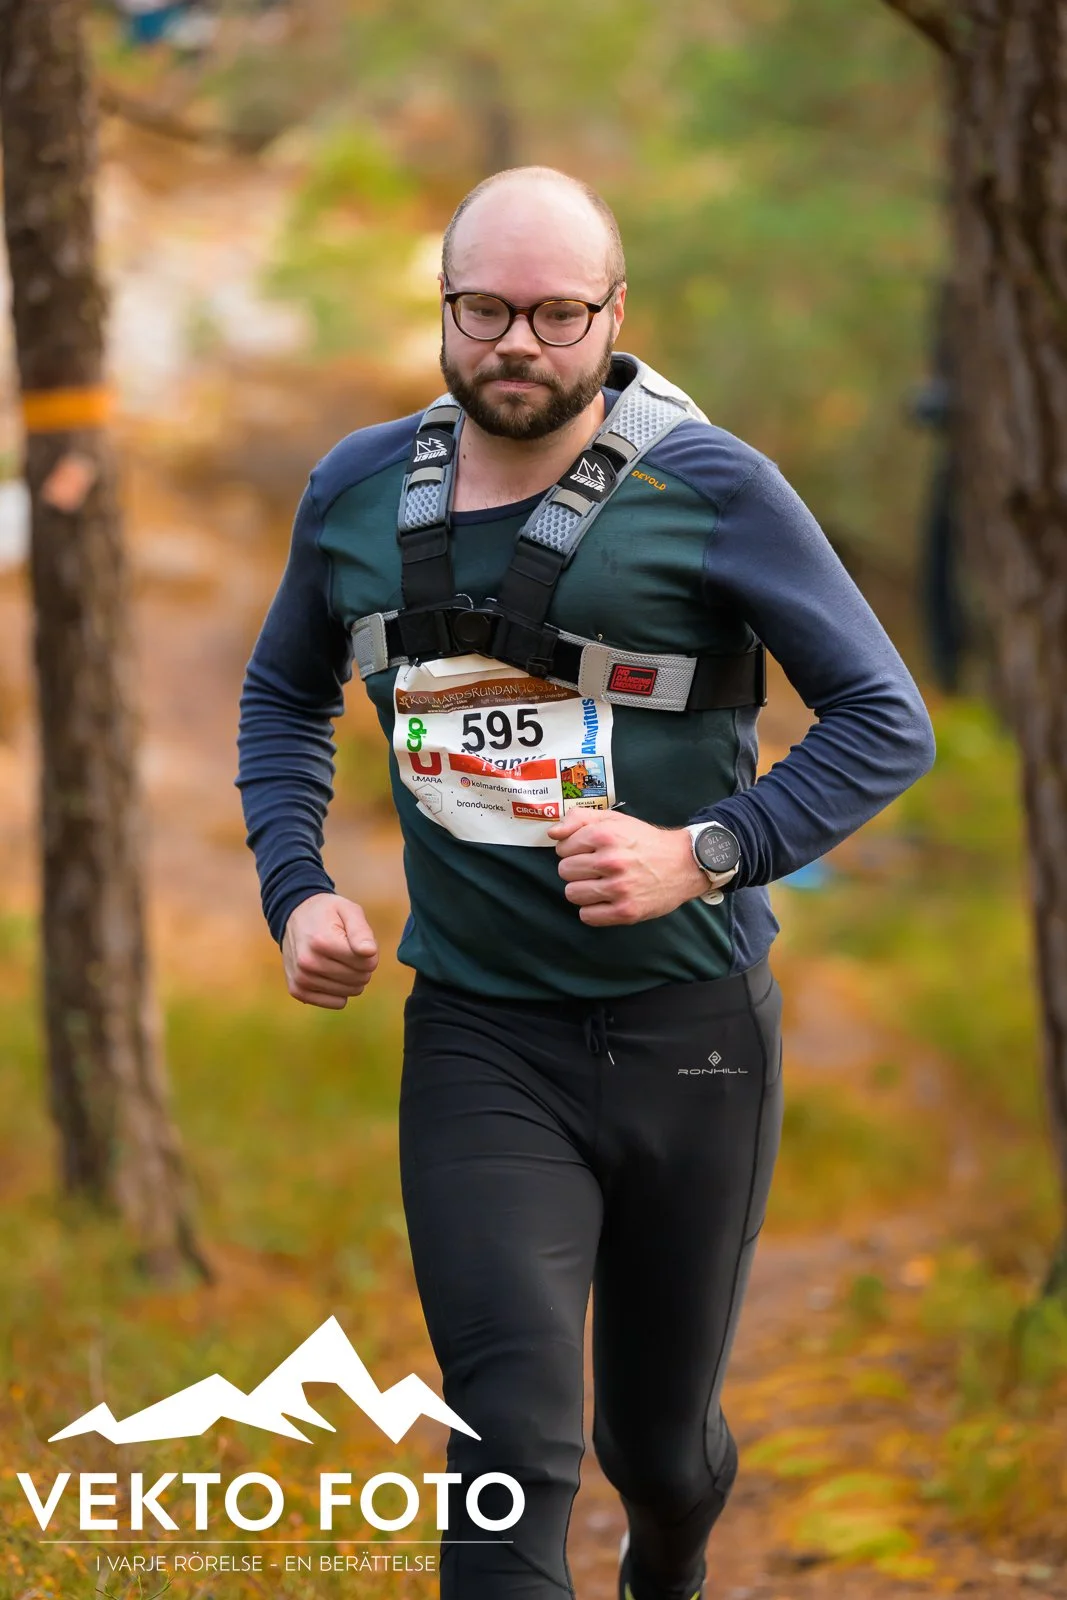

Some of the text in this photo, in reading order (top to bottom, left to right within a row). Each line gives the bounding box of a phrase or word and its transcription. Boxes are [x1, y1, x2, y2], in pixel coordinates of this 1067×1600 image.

[617, 668, 630, 676] NO
[461, 708, 544, 752] 595
[412, 775, 443, 784] UMARA
[471, 780, 549, 795] kolmardsrundantrail
[516, 806, 543, 816] CIRCLE
[677, 1067, 749, 1075] RONHILL
